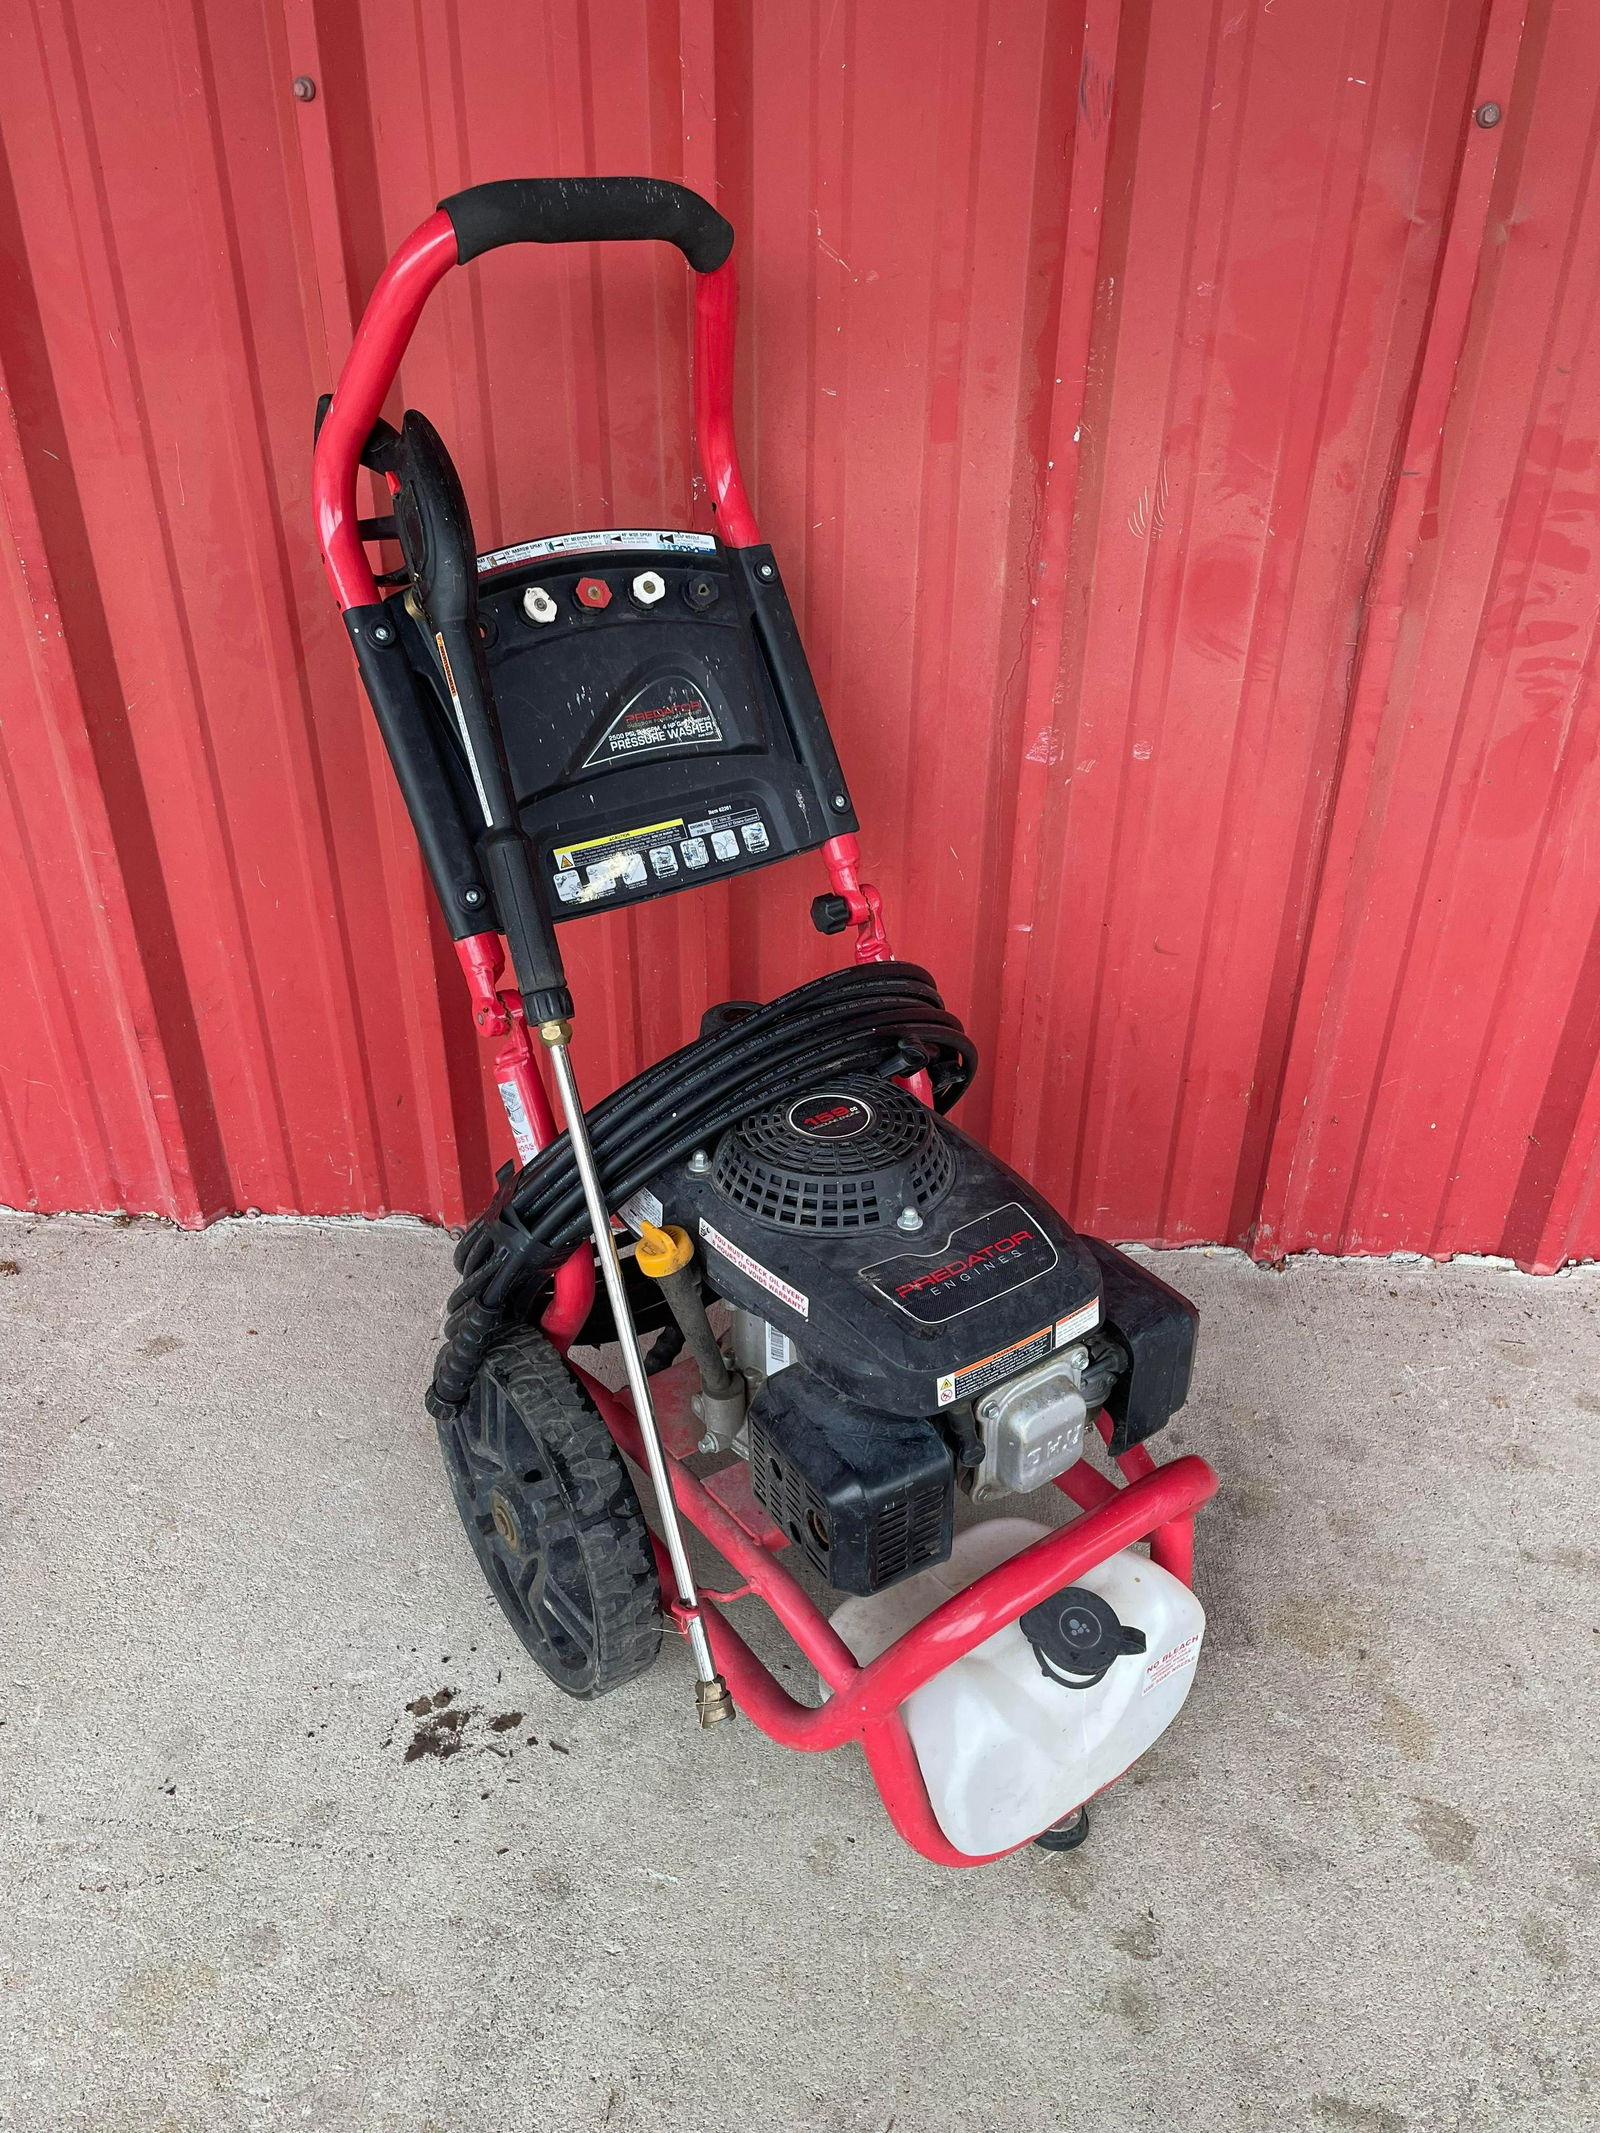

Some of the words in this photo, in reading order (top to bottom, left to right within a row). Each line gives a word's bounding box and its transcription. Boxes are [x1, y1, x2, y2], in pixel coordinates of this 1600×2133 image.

[624, 700, 702, 722] PREDATOR
[610, 731, 666, 751] PRESSURE
[667, 722, 713, 739] WASHER
[708, 1053, 732, 1070] SURFACES
[636, 1083, 648, 1092] DES
[683, 1069, 707, 1087] CHAUDES
[609, 1092, 636, 1112] SURFACES
[729, 1096, 755, 1114] SURFACES
[704, 1112, 728, 1128] CHAUDES
[804, 1106, 849, 1125] 159
[714, 1232, 726, 1246] YOU
[728, 1243, 744, 1259] MUST
[746, 1258, 767, 1278] CHECK
[770, 1275, 780, 1287] OIL
[782, 1284, 804, 1303] EVERY
[895, 1230, 1034, 1299] PREDATOR
[930, 1250, 1024, 1296] ENGINES
[717, 1244, 736, 1263] HOURS
[738, 1261, 747, 1270] OR
[748, 1268, 767, 1286] VOIDS
[769, 1285, 805, 1312] WARRANTY
[1147, 1661, 1159, 1673] NO
[1162, 1635, 1198, 1662] BLEACH
[1172, 1656, 1195, 1672] NOZZLE
